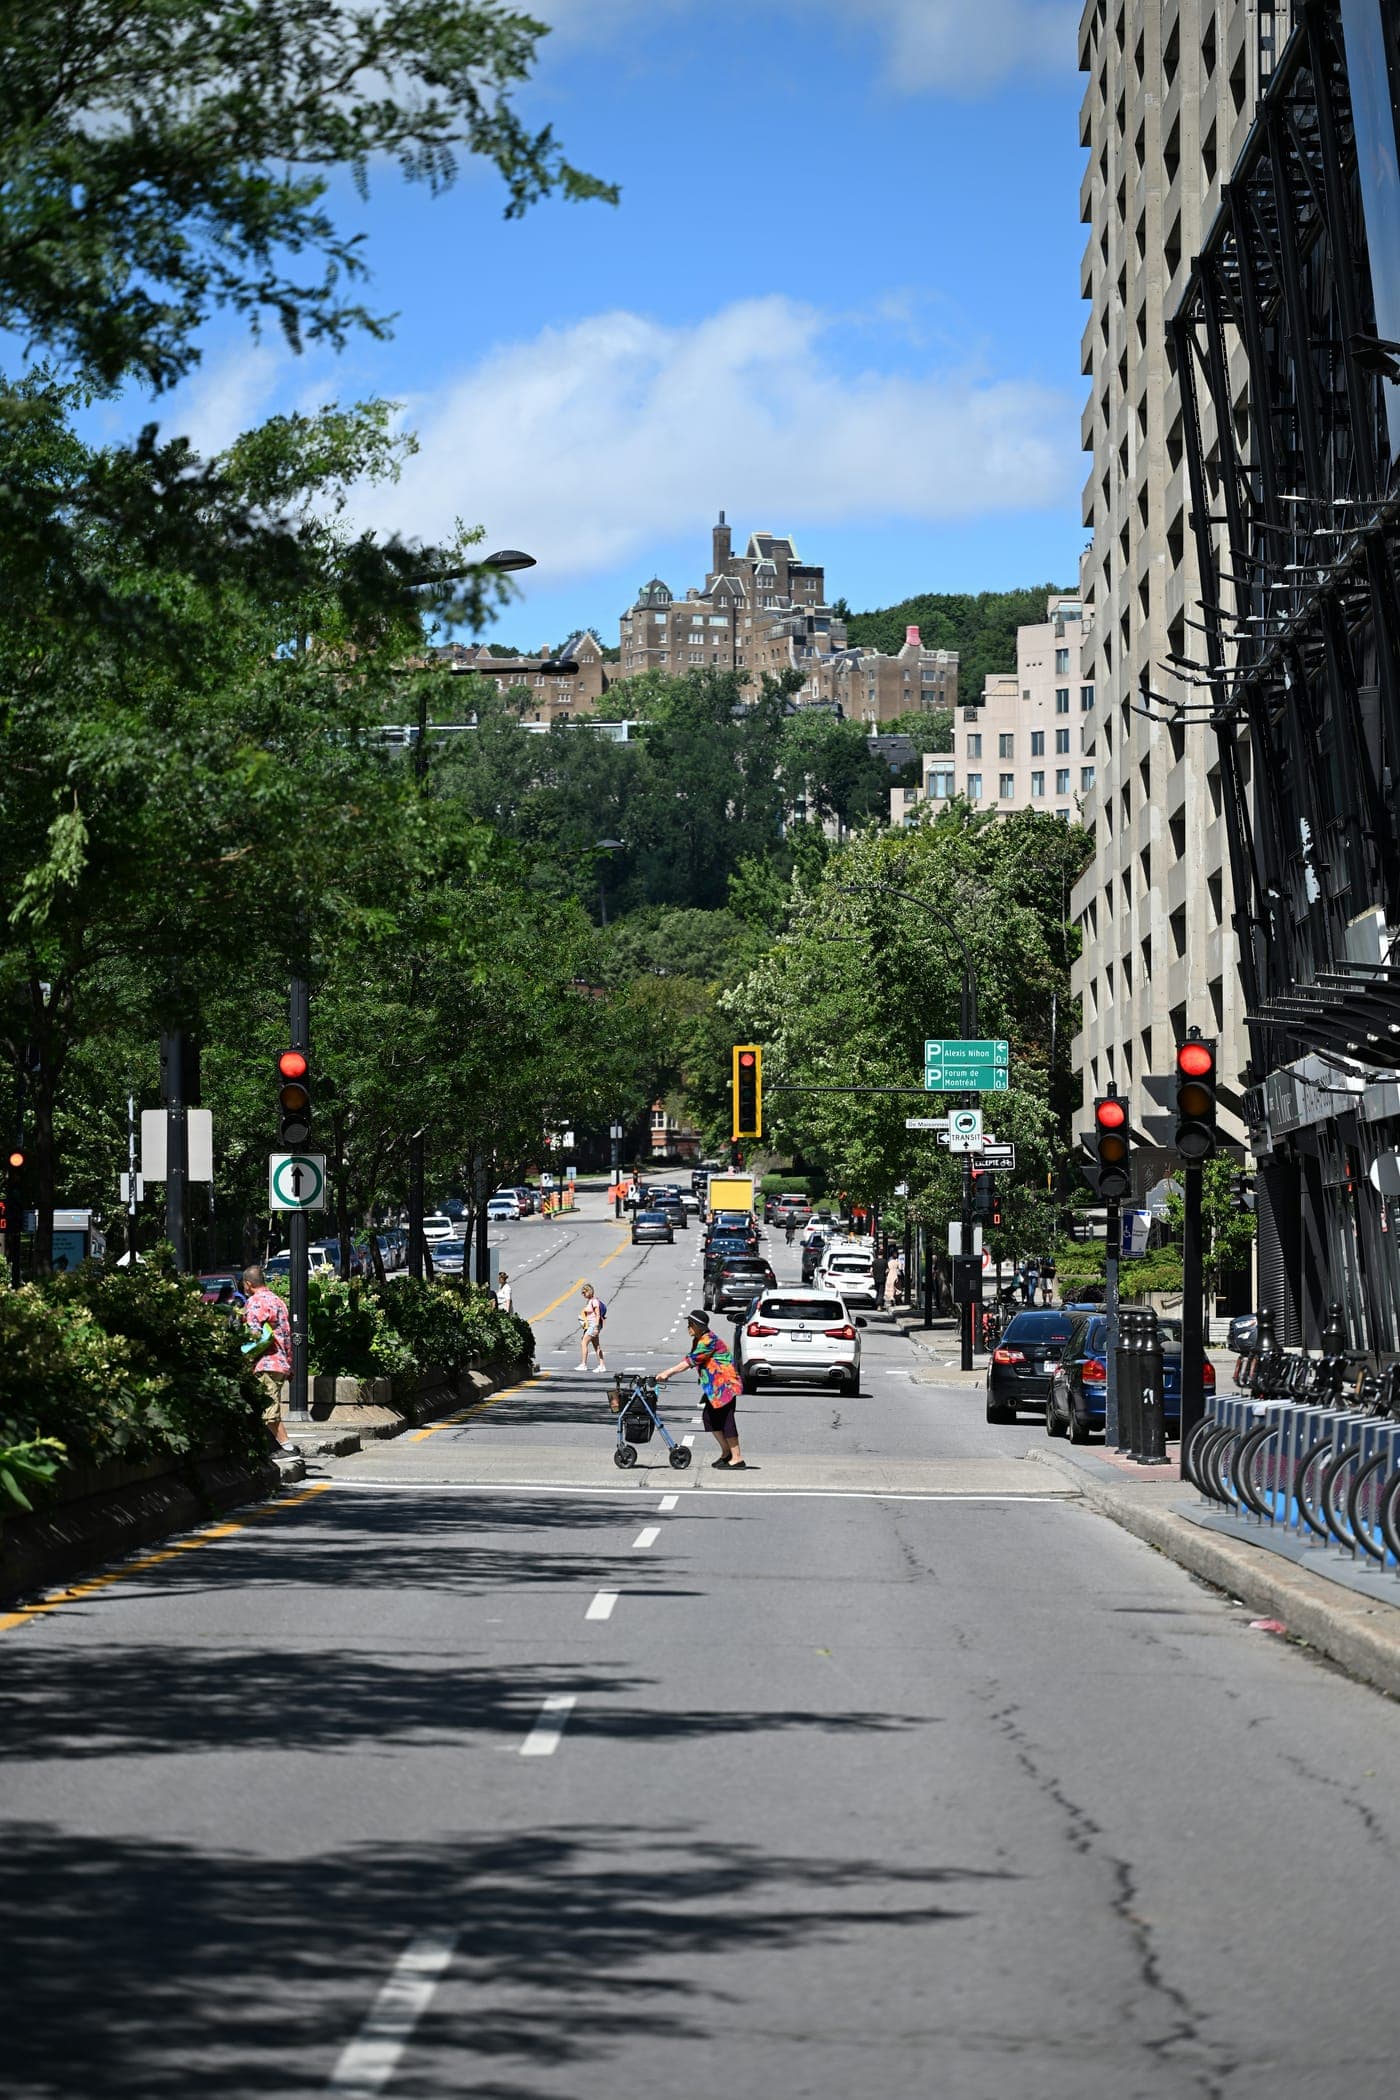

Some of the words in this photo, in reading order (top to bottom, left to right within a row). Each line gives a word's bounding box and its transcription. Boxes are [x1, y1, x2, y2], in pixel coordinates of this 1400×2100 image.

[927, 1044, 941, 1061] P
[945, 1049, 965, 1057] Alexis
[968, 1049, 989, 1057] Nihon
[944, 1069, 967, 1077] Forum
[969, 1069, 979, 1077] de
[927, 1069, 941, 1086] P
[945, 1078, 976, 1086] Montréal
